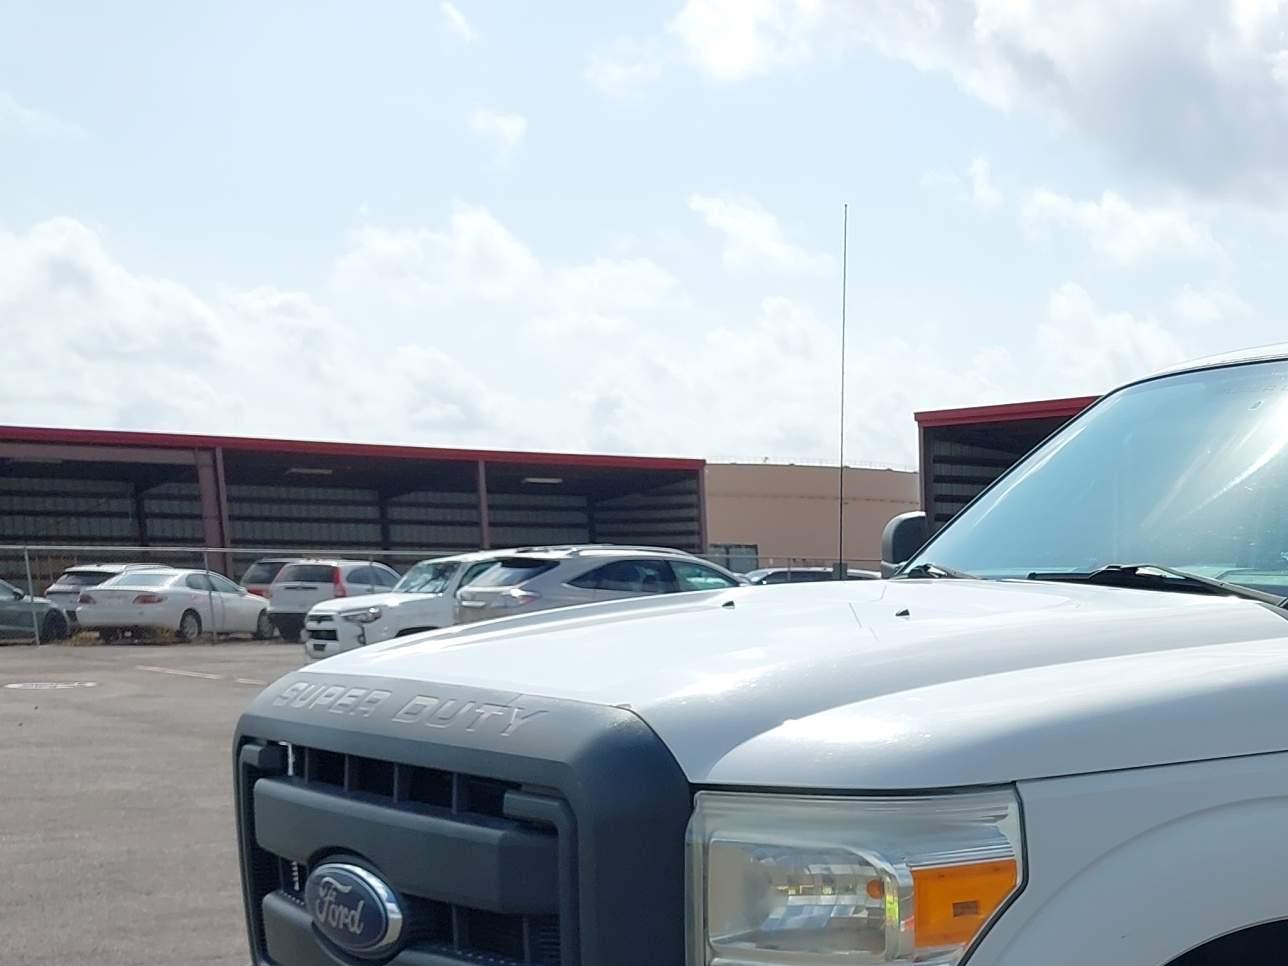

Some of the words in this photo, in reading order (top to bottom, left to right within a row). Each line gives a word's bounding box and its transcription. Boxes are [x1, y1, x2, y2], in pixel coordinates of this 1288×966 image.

[272, 682, 393, 718] SUPER
[391, 694, 550, 737] DUTY
[315, 876, 364, 935] Ford
